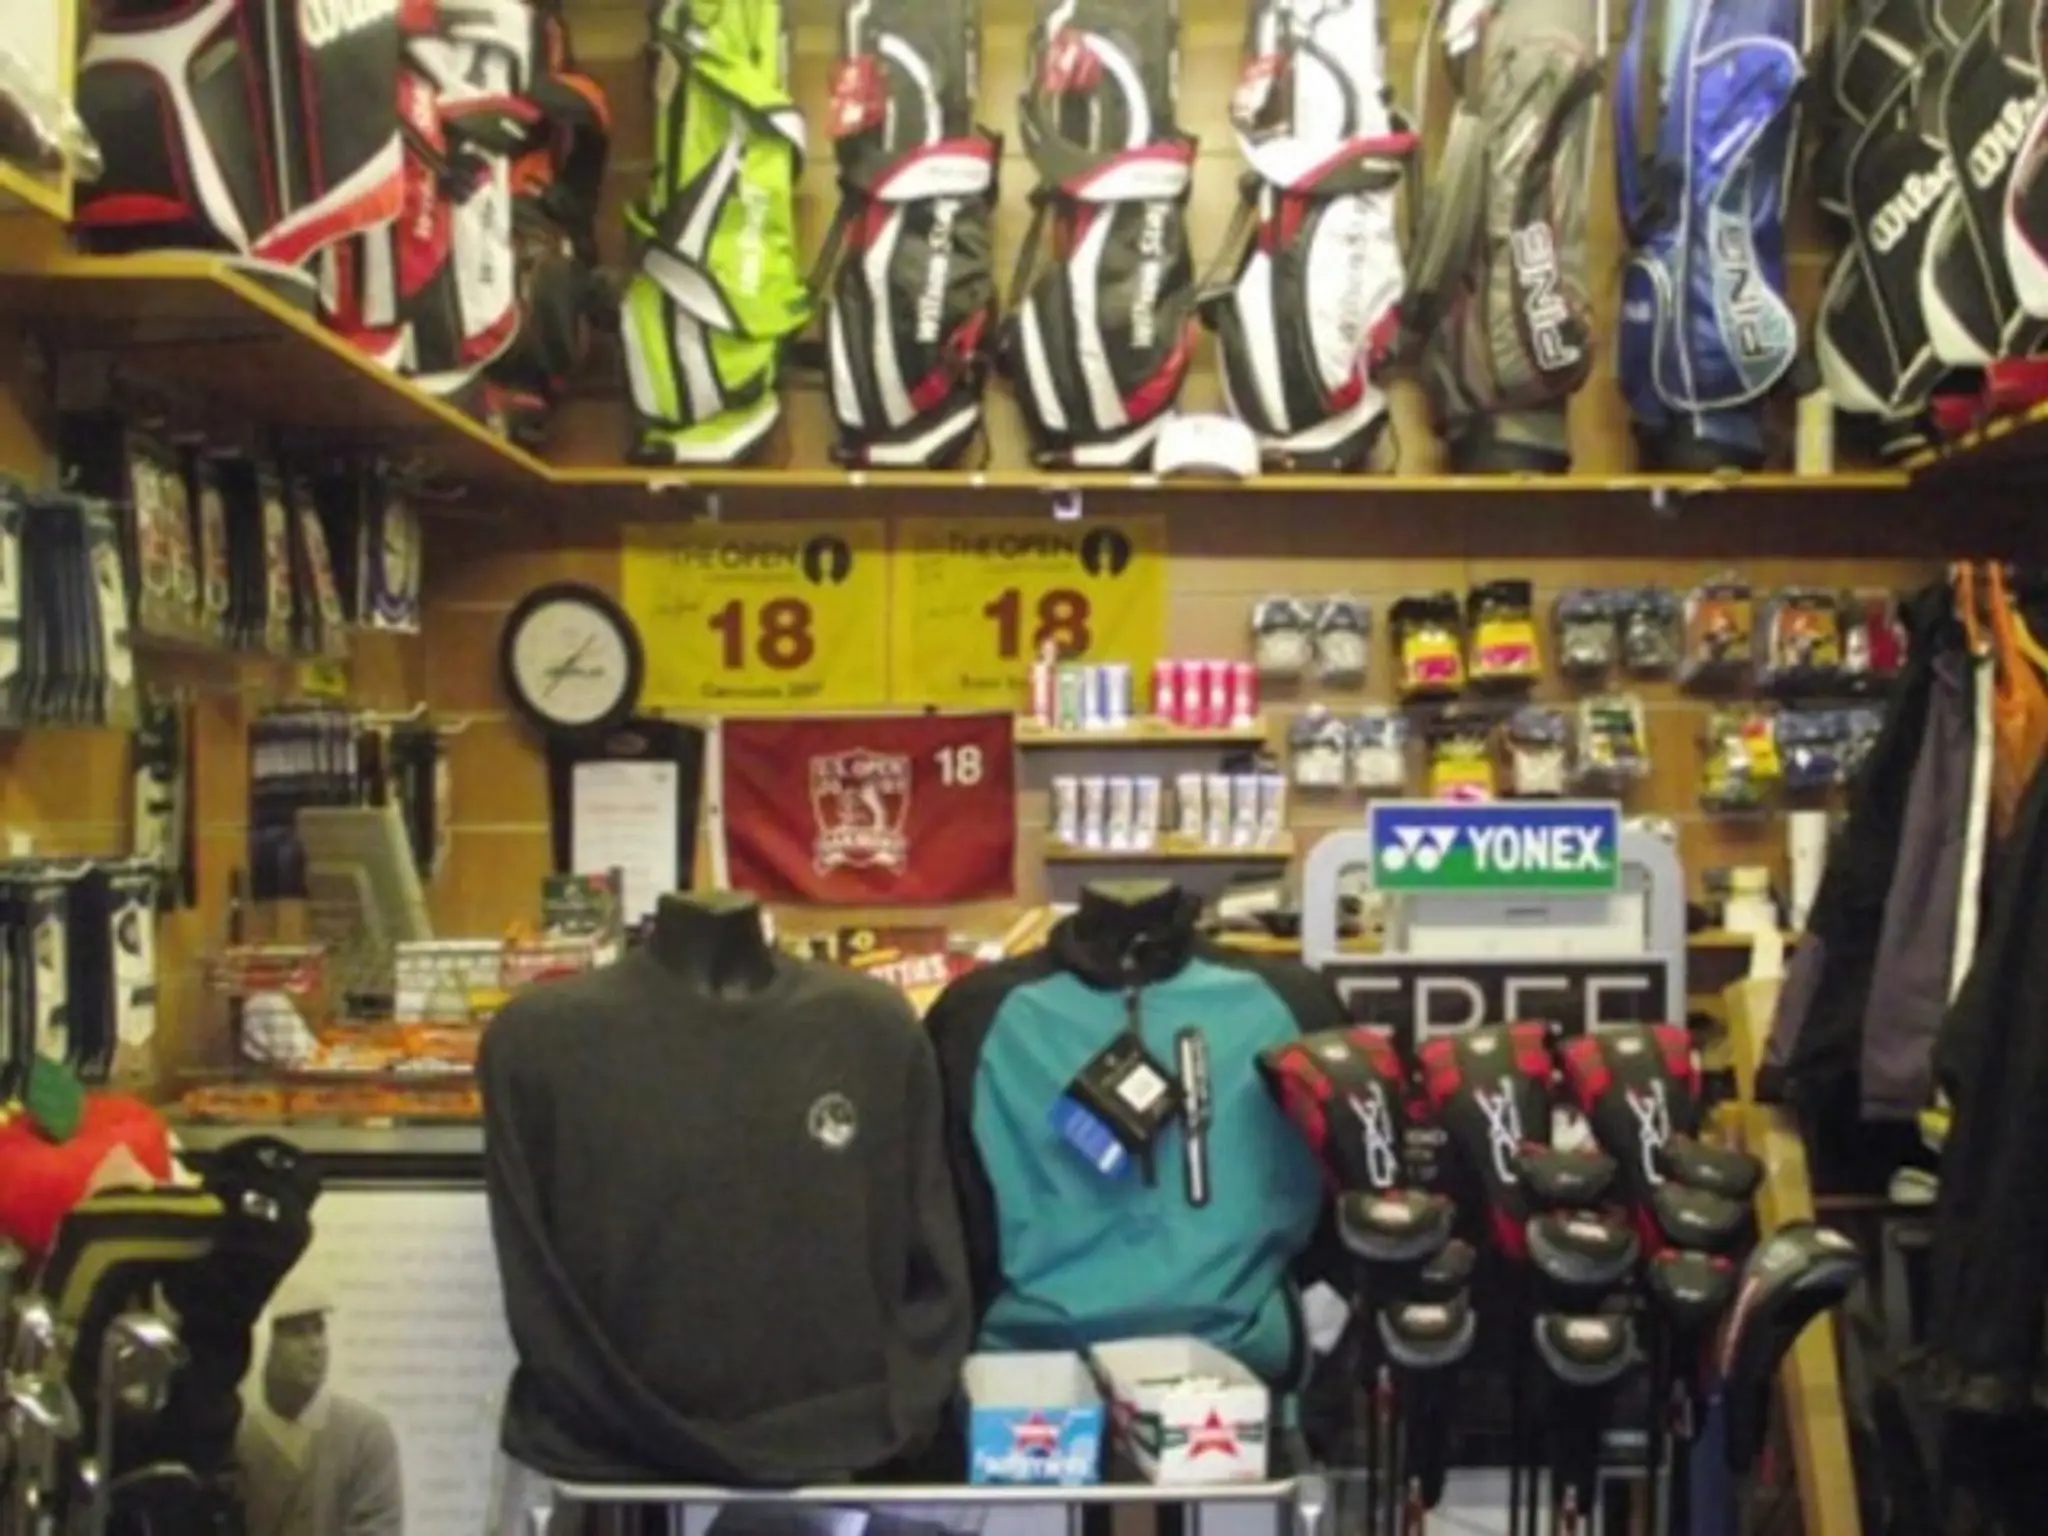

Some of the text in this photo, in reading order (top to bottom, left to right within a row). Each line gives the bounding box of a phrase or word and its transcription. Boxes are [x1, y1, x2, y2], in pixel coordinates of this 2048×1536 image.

[1511, 221, 1581, 370] PING
[1716, 225, 1775, 358] PING
[708, 597, 816, 672] 18
[982, 586, 1093, 663] 18
[932, 744, 983, 787] 18
[1467, 824, 1604, 872] YONEX
